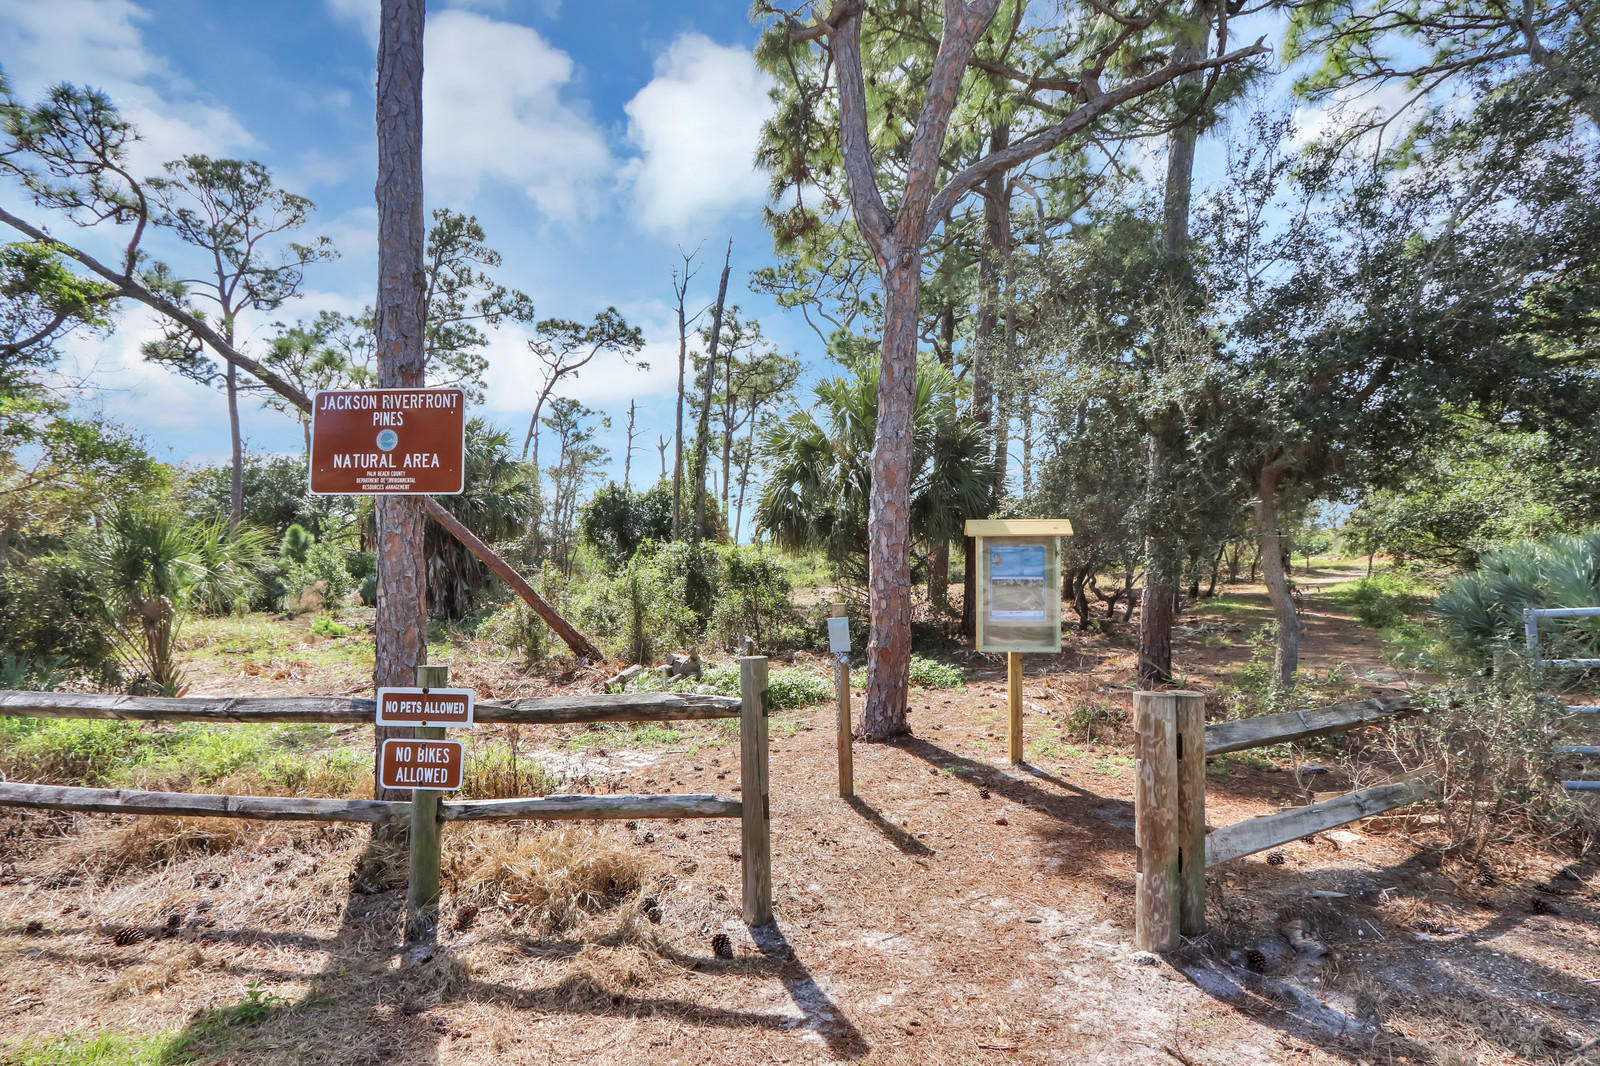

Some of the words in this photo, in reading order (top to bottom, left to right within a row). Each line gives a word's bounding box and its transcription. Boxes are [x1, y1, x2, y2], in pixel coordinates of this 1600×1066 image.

[320, 395, 377, 410] JACKSON
[382, 393, 458, 409] RIVERFRONT
[372, 411, 404, 426] PINES
[333, 453, 396, 469] NATURAL
[403, 453, 440, 468] AREA
[385, 701, 398, 713] NO
[400, 701, 422, 714] PETS
[424, 702, 465, 714] ALLOWED
[396, 747, 412, 762] NO
[417, 748, 450, 764] BIKES
[396, 767, 448, 783] ALLOWED
